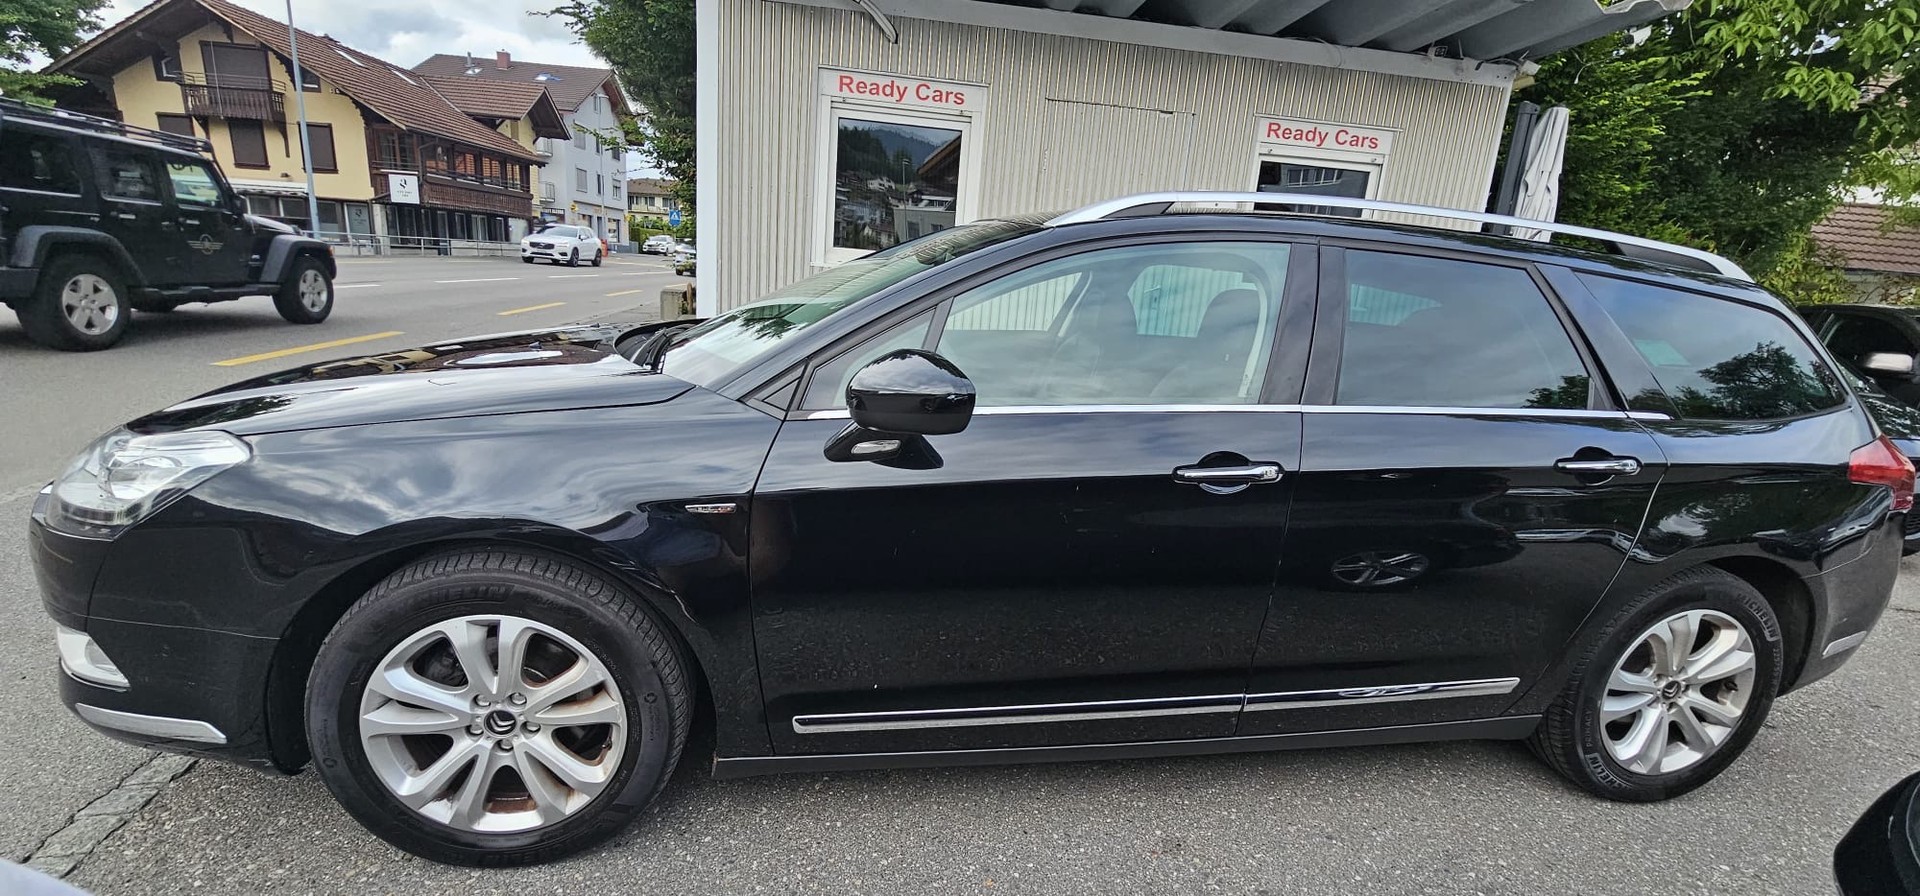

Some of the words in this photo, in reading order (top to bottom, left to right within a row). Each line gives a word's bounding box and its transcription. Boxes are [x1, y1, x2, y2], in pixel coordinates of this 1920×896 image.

[838, 75, 908, 103] Ready
[915, 83, 966, 105] Cars
[1266, 122, 1329, 147] Ready
[1335, 129, 1379, 149] Cars
[1737, 592, 1778, 638] MICHELIN
